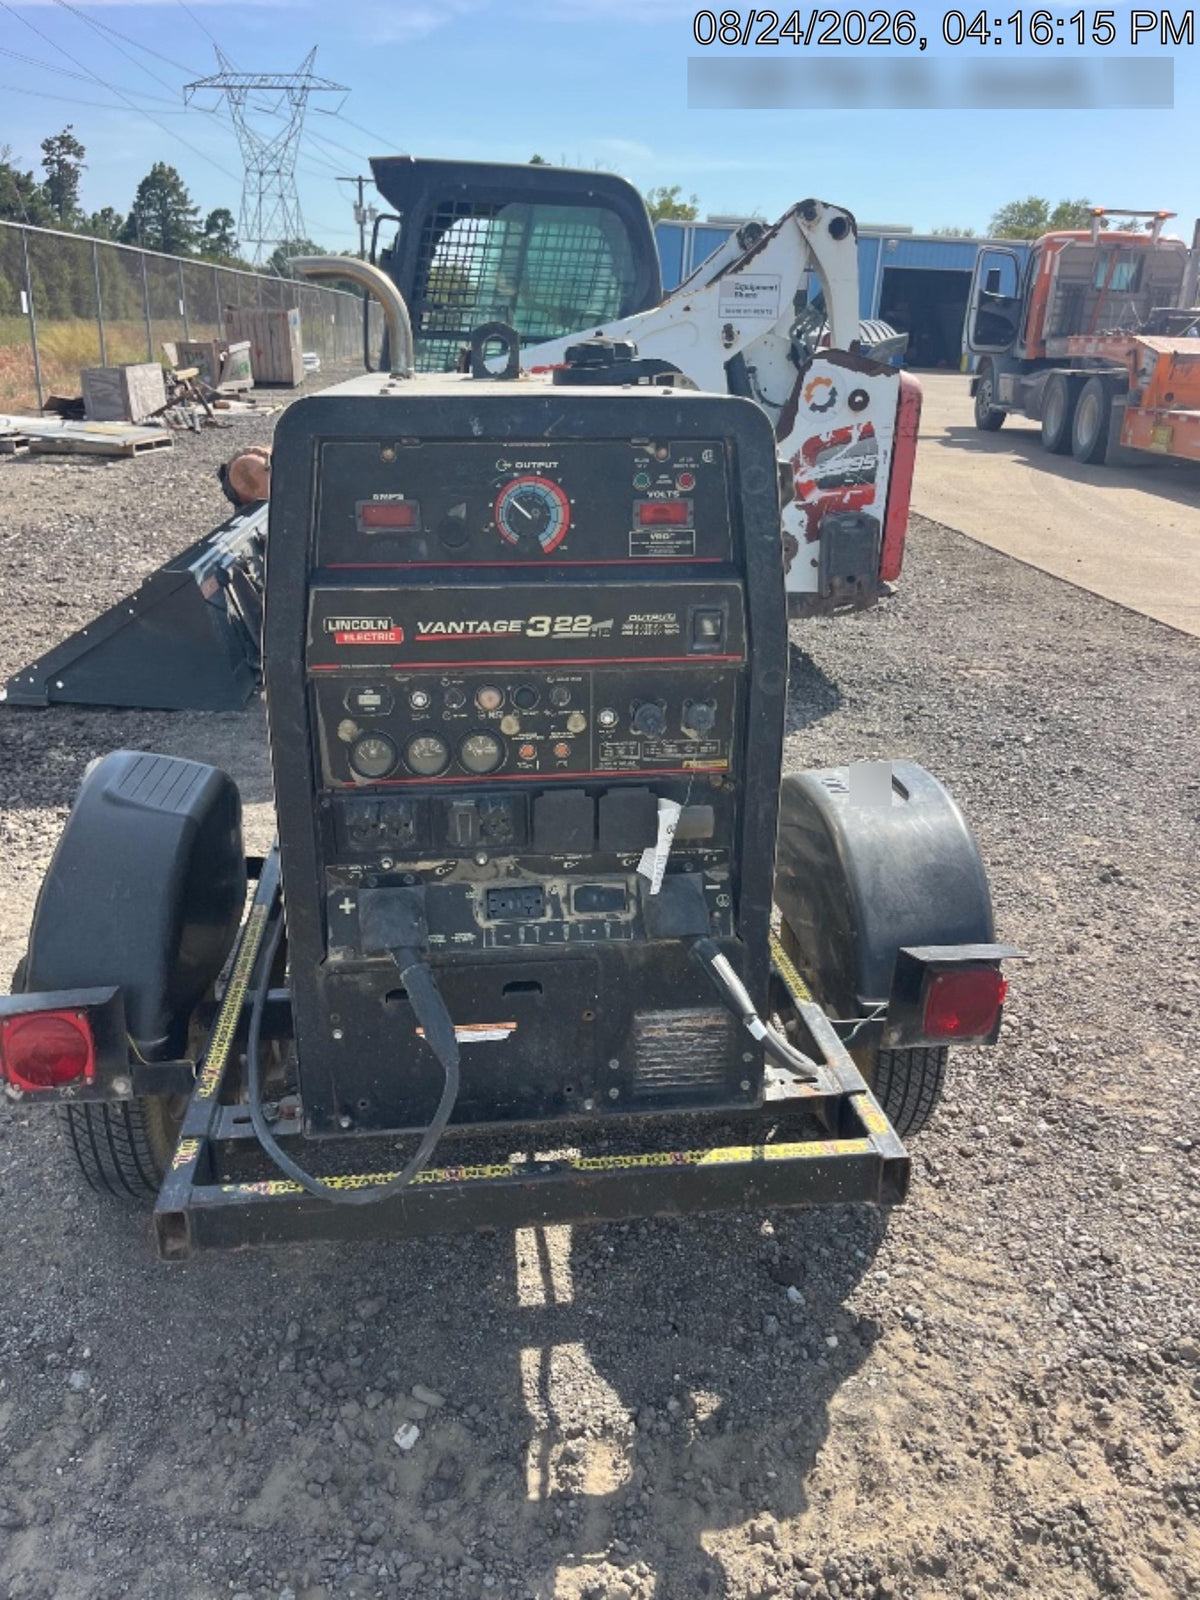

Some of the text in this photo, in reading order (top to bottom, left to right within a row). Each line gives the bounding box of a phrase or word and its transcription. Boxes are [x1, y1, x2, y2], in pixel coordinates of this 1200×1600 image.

[514, 461, 559, 469] OUTPUT
[646, 490, 680, 498] VOLTS
[327, 619, 389, 631] LINCOLN
[416, 614, 593, 638] VANTAGE 322
[342, 631, 396, 642] ELECTRIC
